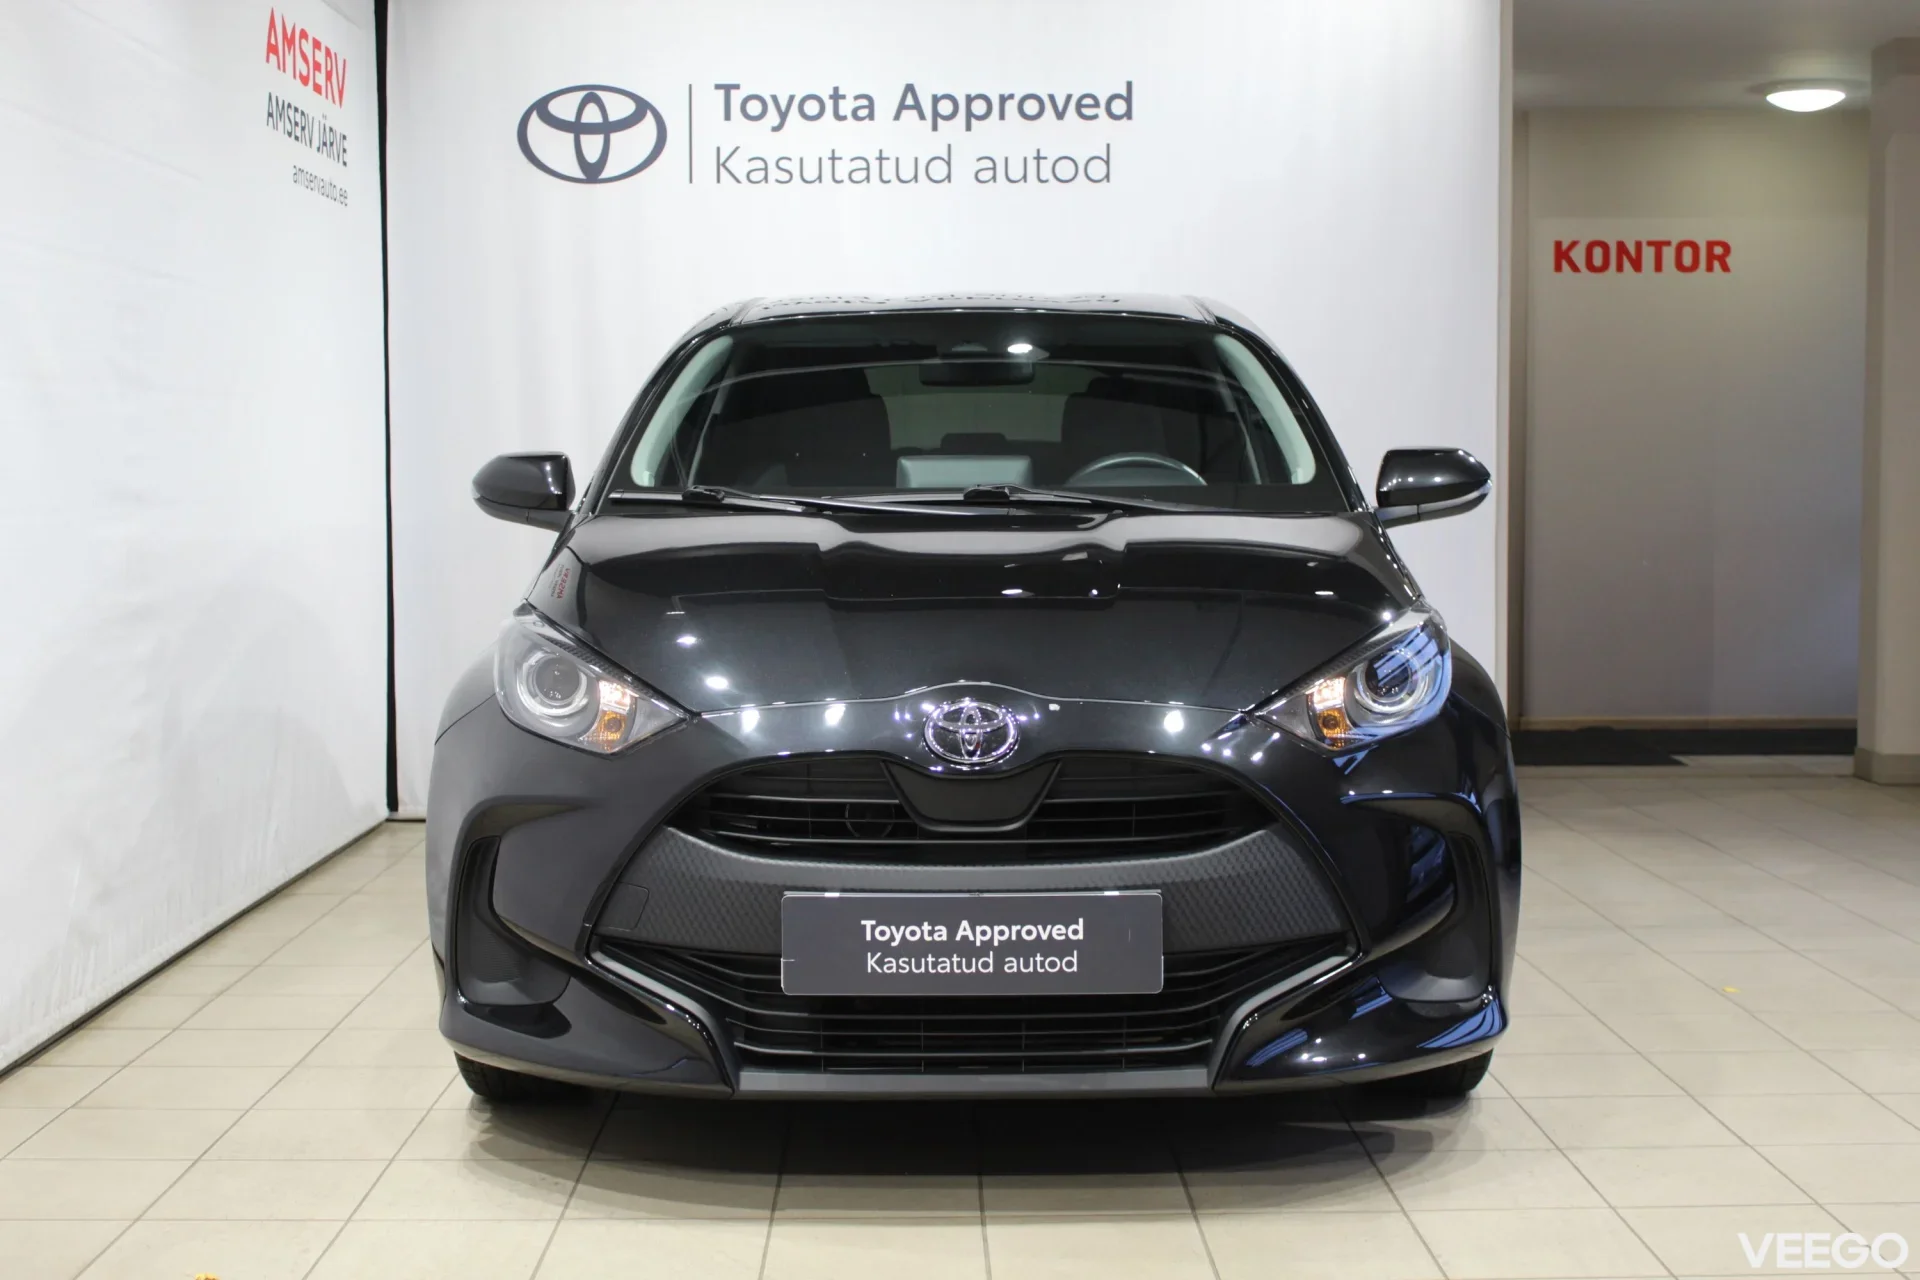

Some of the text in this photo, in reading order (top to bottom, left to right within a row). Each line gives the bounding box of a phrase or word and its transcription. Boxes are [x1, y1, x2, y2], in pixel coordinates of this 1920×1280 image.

[266, 7, 347, 109] AMSERV
[714, 81, 1134, 133] Toyota Approved
[266, 92, 348, 168] AMSERV JÄRVE
[715, 144, 1112, 184] Kasutatud autod
[292, 164, 349, 207] amservauto.ee
[1553, 239, 1732, 273] KONTOR
[861, 918, 1085, 947] Toyota Approved
[866, 950, 1079, 974] Kasutatud autod
